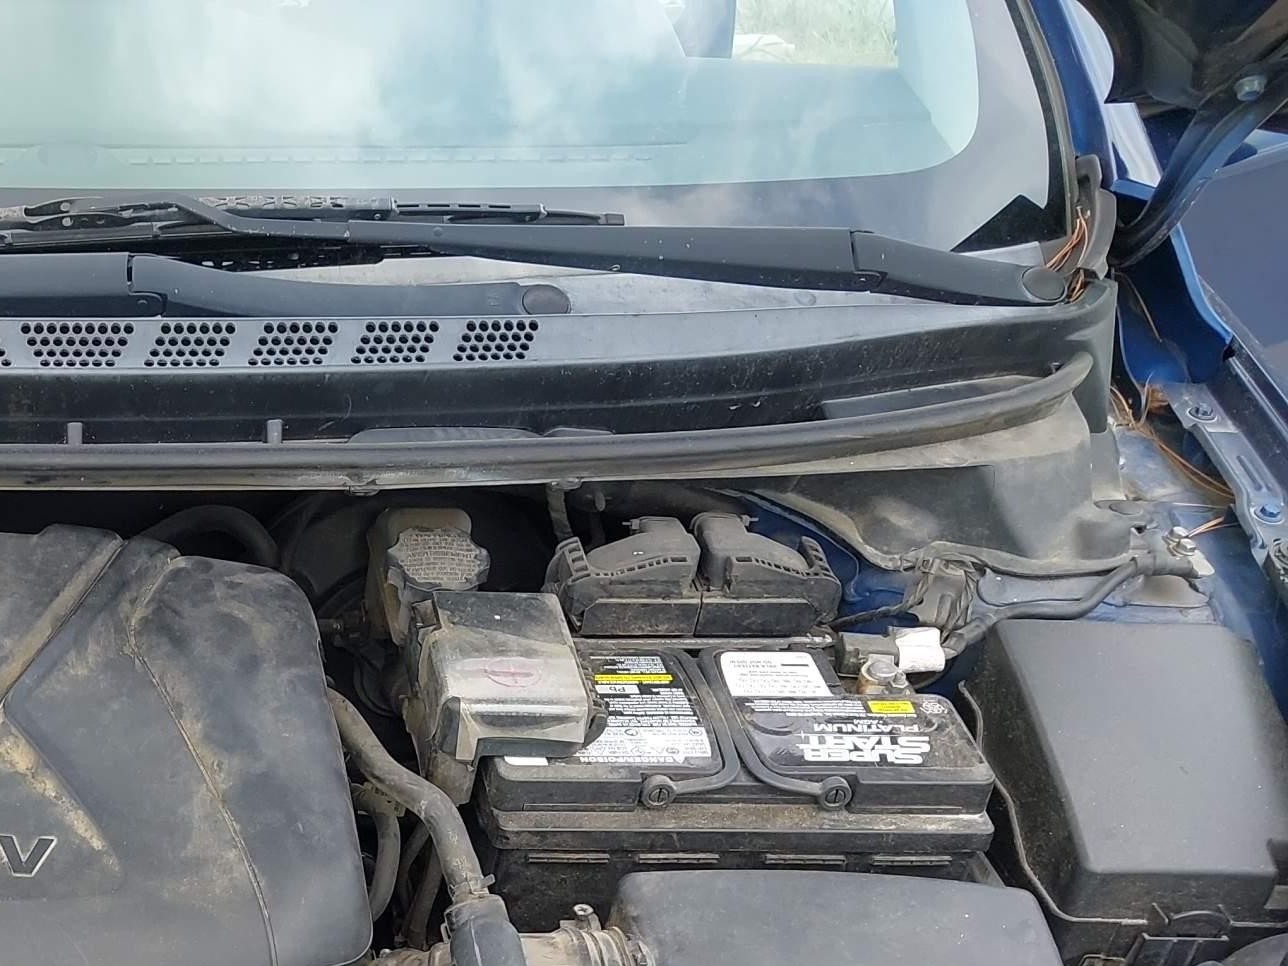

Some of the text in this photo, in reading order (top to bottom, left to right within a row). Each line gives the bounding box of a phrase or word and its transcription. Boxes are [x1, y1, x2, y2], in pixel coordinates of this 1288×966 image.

[813, 723, 920, 733] PLATINUM
[795, 734, 930, 753] START
[802, 748, 924, 764] SUPER
